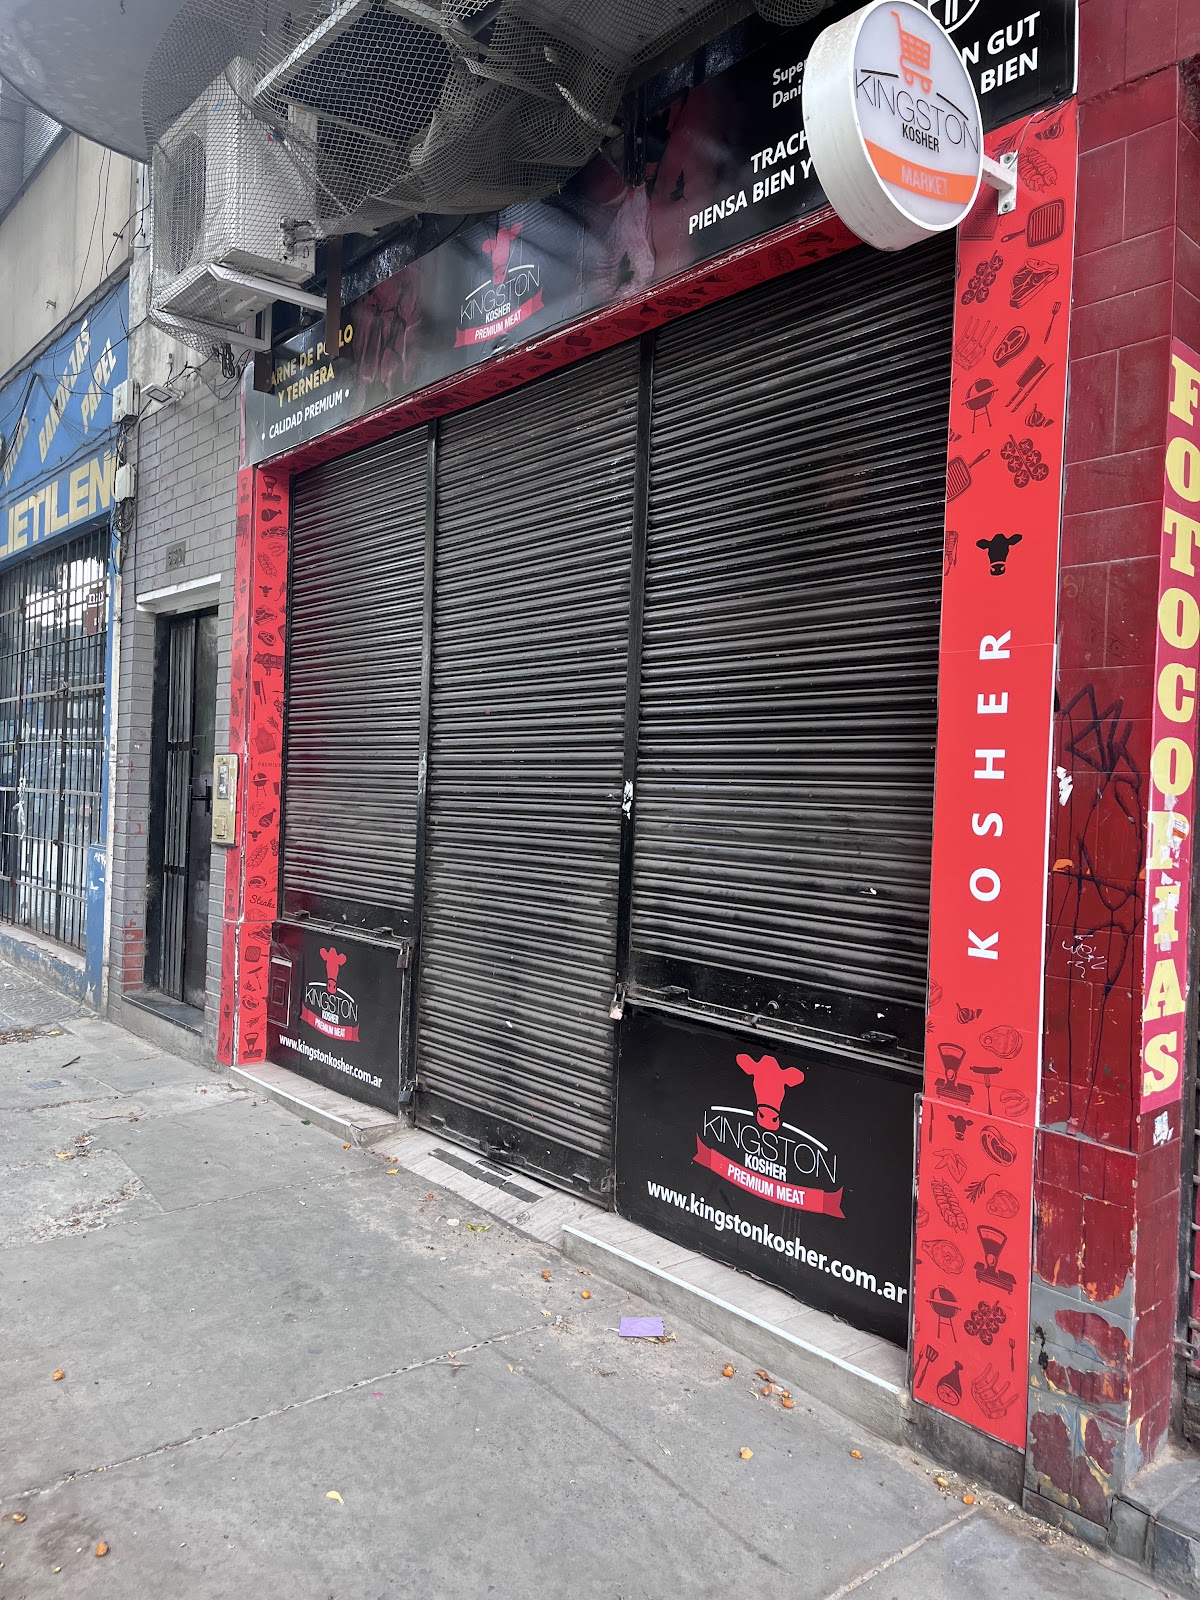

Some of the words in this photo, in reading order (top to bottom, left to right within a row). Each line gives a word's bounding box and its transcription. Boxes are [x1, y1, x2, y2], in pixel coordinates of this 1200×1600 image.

[987, 11, 1040, 56] GUT
[773, 79, 801, 109] Dani
[981, 47, 1038, 95] BIEN
[855, 68, 979, 154] KINGSTON
[902, 122, 940, 154] KOSHER
[689, 190, 748, 235] PIENSA
[753, 165, 795, 203] BIEN
[801, 157, 813, 179] Y
[901, 164, 949, 200] MARKET
[460, 265, 540, 324] KINGSTON
[485, 302, 511, 324] KOSHER
[474, 321, 504, 341] PREMIUM
[505, 309, 523, 329] MEAT
[271, 358, 297, 386] ARNE
[299, 347, 314, 370] DE
[317, 324, 354, 360] POLO
[38, 319, 92, 464] BANDEJAS
[81, 337, 117, 434] PAPEL
[278, 390, 286, 409] Y
[286, 362, 335, 403] TERNERA
[268, 411, 303, 440] CALIDAD
[304, 388, 344, 422] PREMIUM
[1143, 353, 1200, 1094] FOTOCOPIAS
[967, 628, 1014, 961] KOSHER
[249, 894, 276, 910] Steaks
[305, 986, 358, 1022] KINGSTON
[322, 1010, 339, 1025] KOSHER
[314, 1019, 333, 1036] PREMIUM
[333, 1026, 347, 1038] MEAT
[279, 1034, 383, 1089] www.kingstonkosher.com.ar
[703, 1111, 837, 1184] KINGSTON
[744, 1153, 787, 1182] KOSHER
[727, 1163, 774, 1197] PREMIUM
[776, 1184, 806, 1206] MEAT
[647, 1180, 908, 1304] www.kingstonkosher.com.ar
